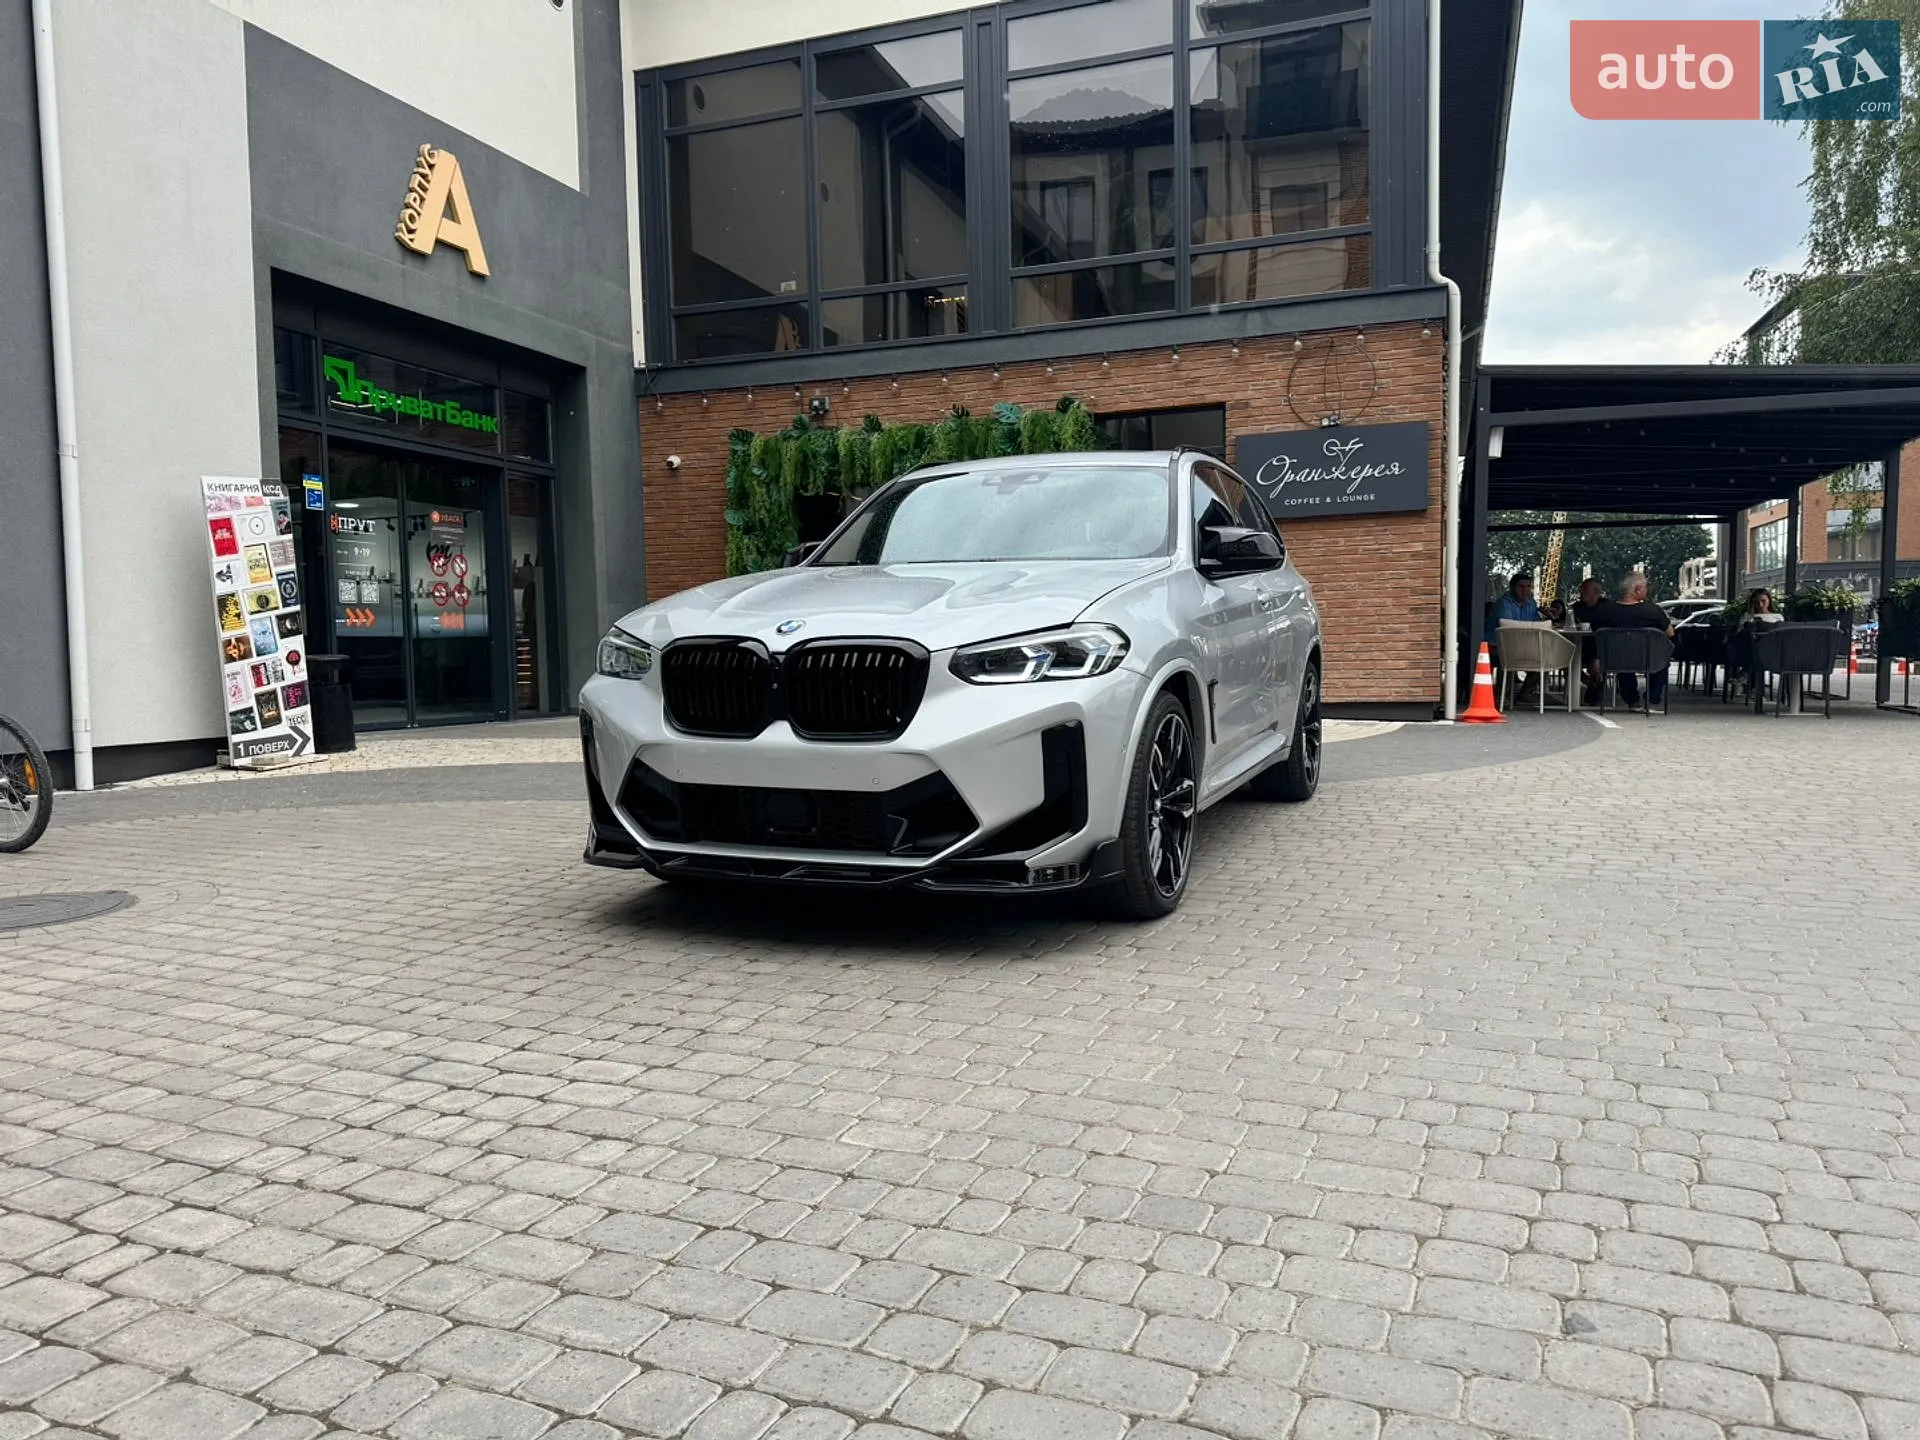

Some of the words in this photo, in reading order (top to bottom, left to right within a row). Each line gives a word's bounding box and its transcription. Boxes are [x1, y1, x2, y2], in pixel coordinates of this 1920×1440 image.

[395, 143, 438, 247] КОРПУС
[357, 378, 499, 434] ПриватБанк
[1256, 437, 1406, 499] Оранжерея
[207, 483, 260, 493] КНИГАРНЯ
[263, 484, 281, 494] КСД
[1284, 496, 1321, 506] COFFEE
[1337, 493, 1376, 503] LOUNGE
[338, 517, 375, 532] ПРУТ
[238, 743, 244, 756] 1
[249, 740, 290, 755] ПОВЕРХ
